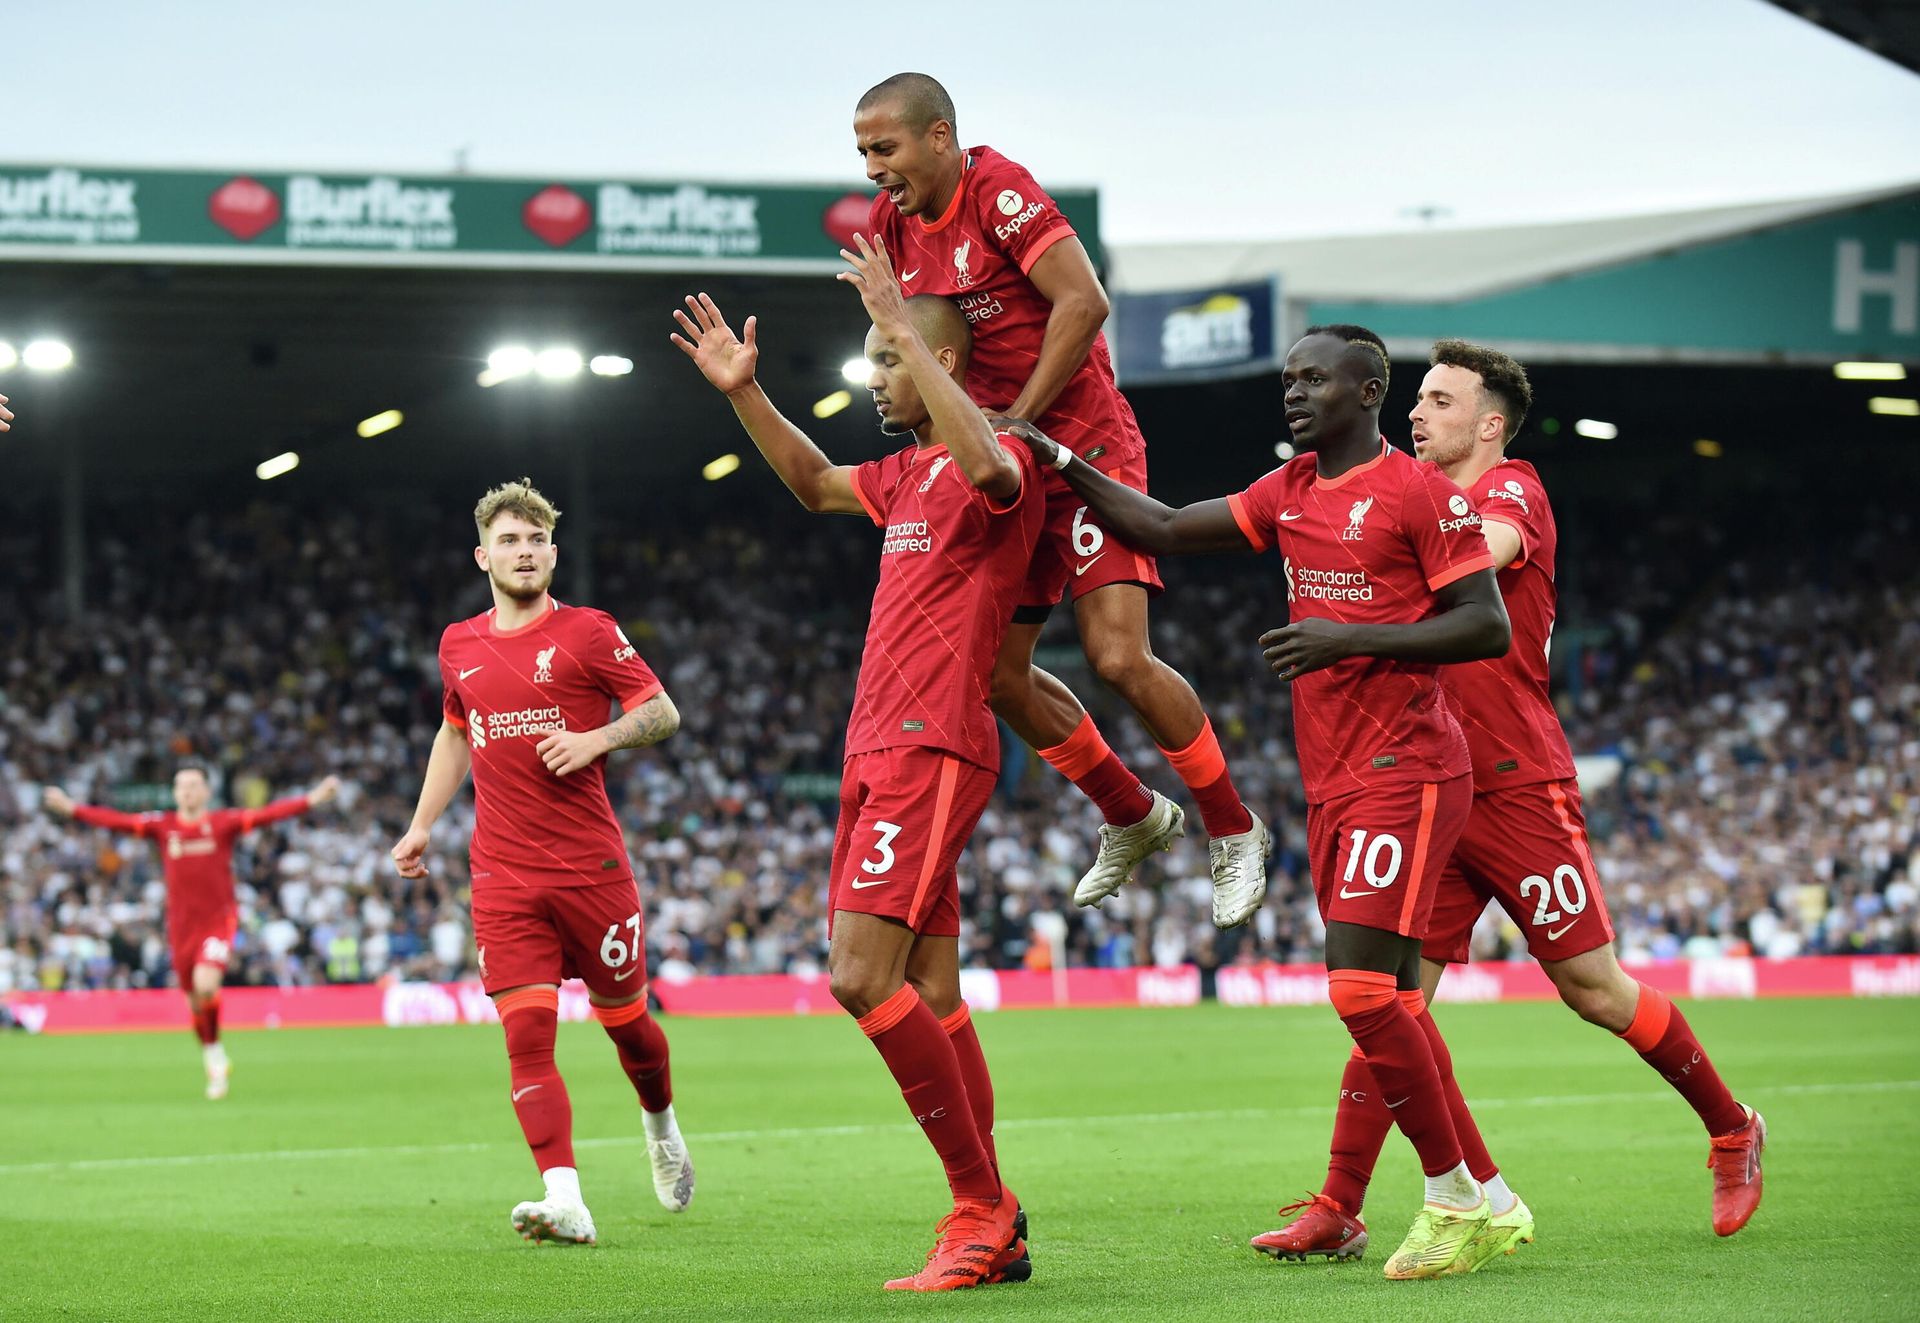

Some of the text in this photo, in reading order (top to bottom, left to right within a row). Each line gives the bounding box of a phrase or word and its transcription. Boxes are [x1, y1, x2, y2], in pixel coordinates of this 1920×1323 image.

[0, 167, 136, 216] urflex
[286, 175, 454, 223] Burflex
[598, 183, 759, 231] Burflex
[1834, 238, 1918, 334] H
[1439, 512, 1482, 532] Expedia
[1487, 489, 1529, 514] Expedia
[1072, 506, 1104, 557] 6
[1298, 566, 1365, 585] standard
[1298, 583, 1373, 601] chartered
[488, 705, 560, 726] standard
[489, 718, 566, 739] chartered
[861, 821, 902, 875] 3
[1343, 829, 1403, 888] 10
[1520, 864, 1587, 926] 20
[600, 912, 640, 968] 67
